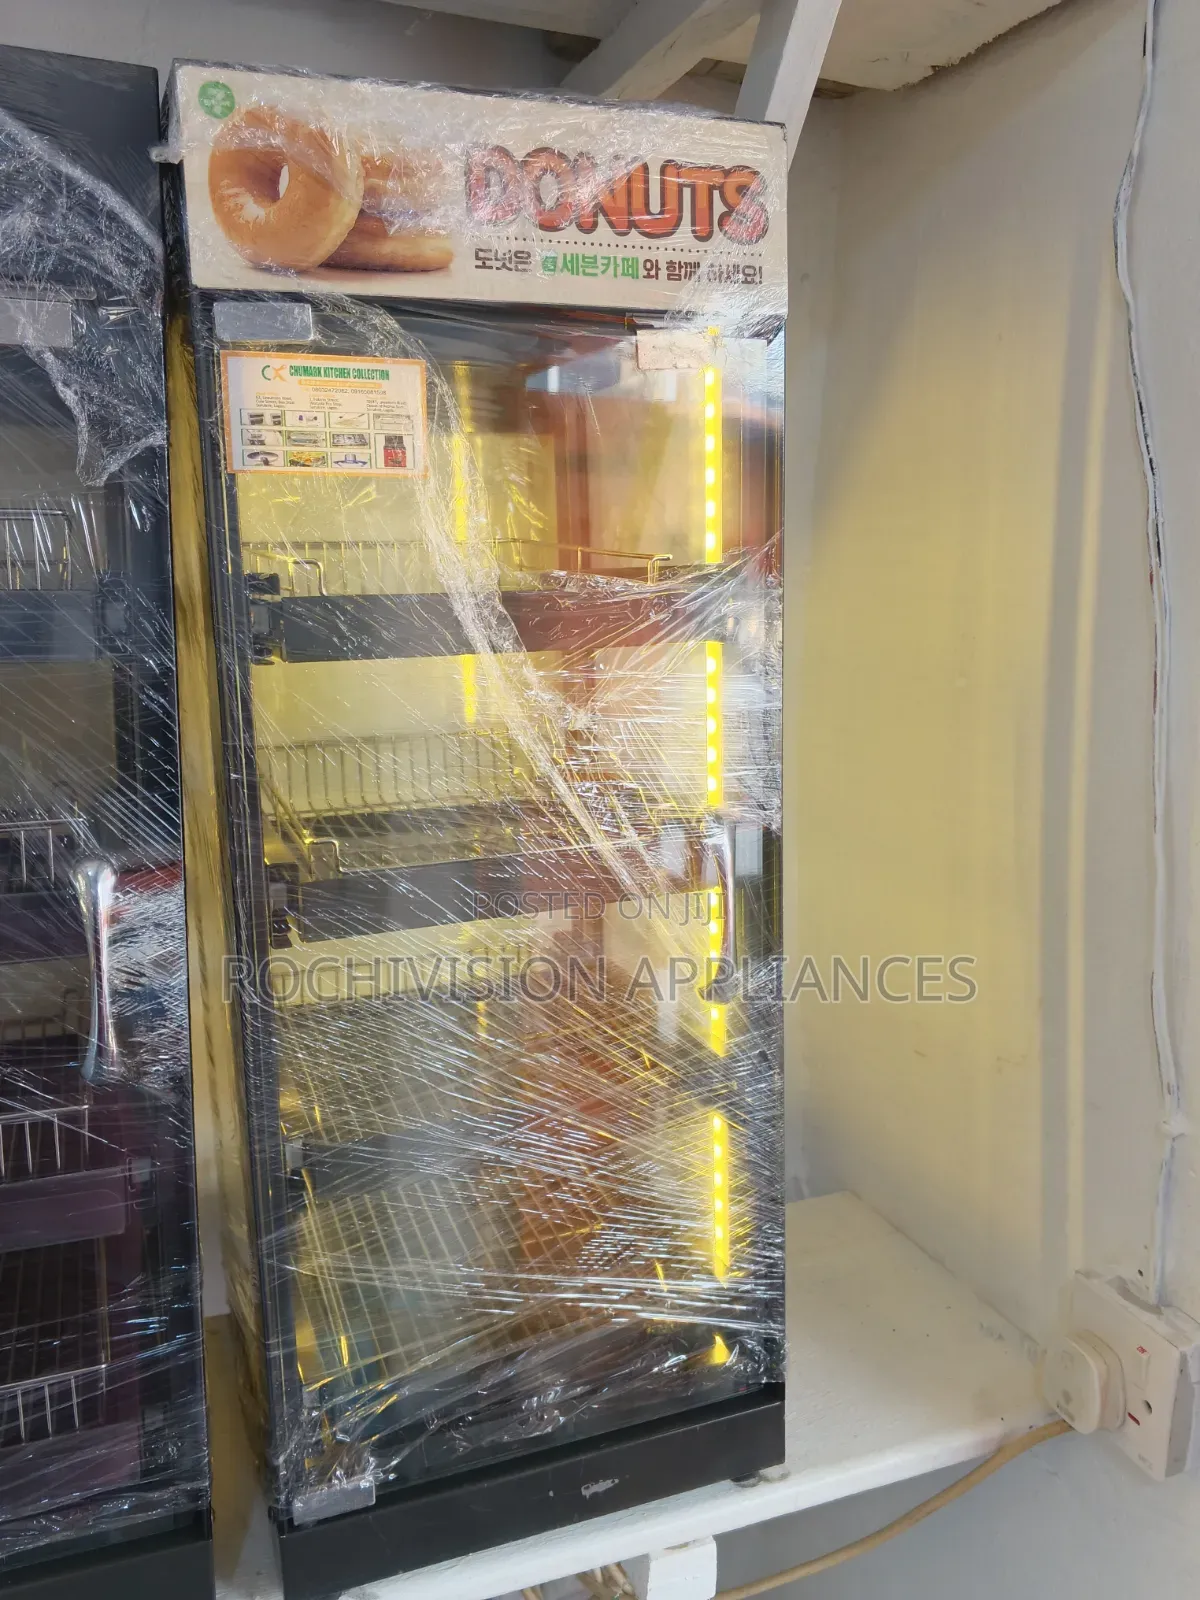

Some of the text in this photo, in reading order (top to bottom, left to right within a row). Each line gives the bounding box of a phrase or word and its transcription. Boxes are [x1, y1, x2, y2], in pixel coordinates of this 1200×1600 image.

[463, 146, 769, 245] DONUTS
[474, 247, 533, 273] 도넛은
[665, 259, 701, 282] 함께
[289, 365, 390, 381] CHUMARK KITCHEN COLLECTION
